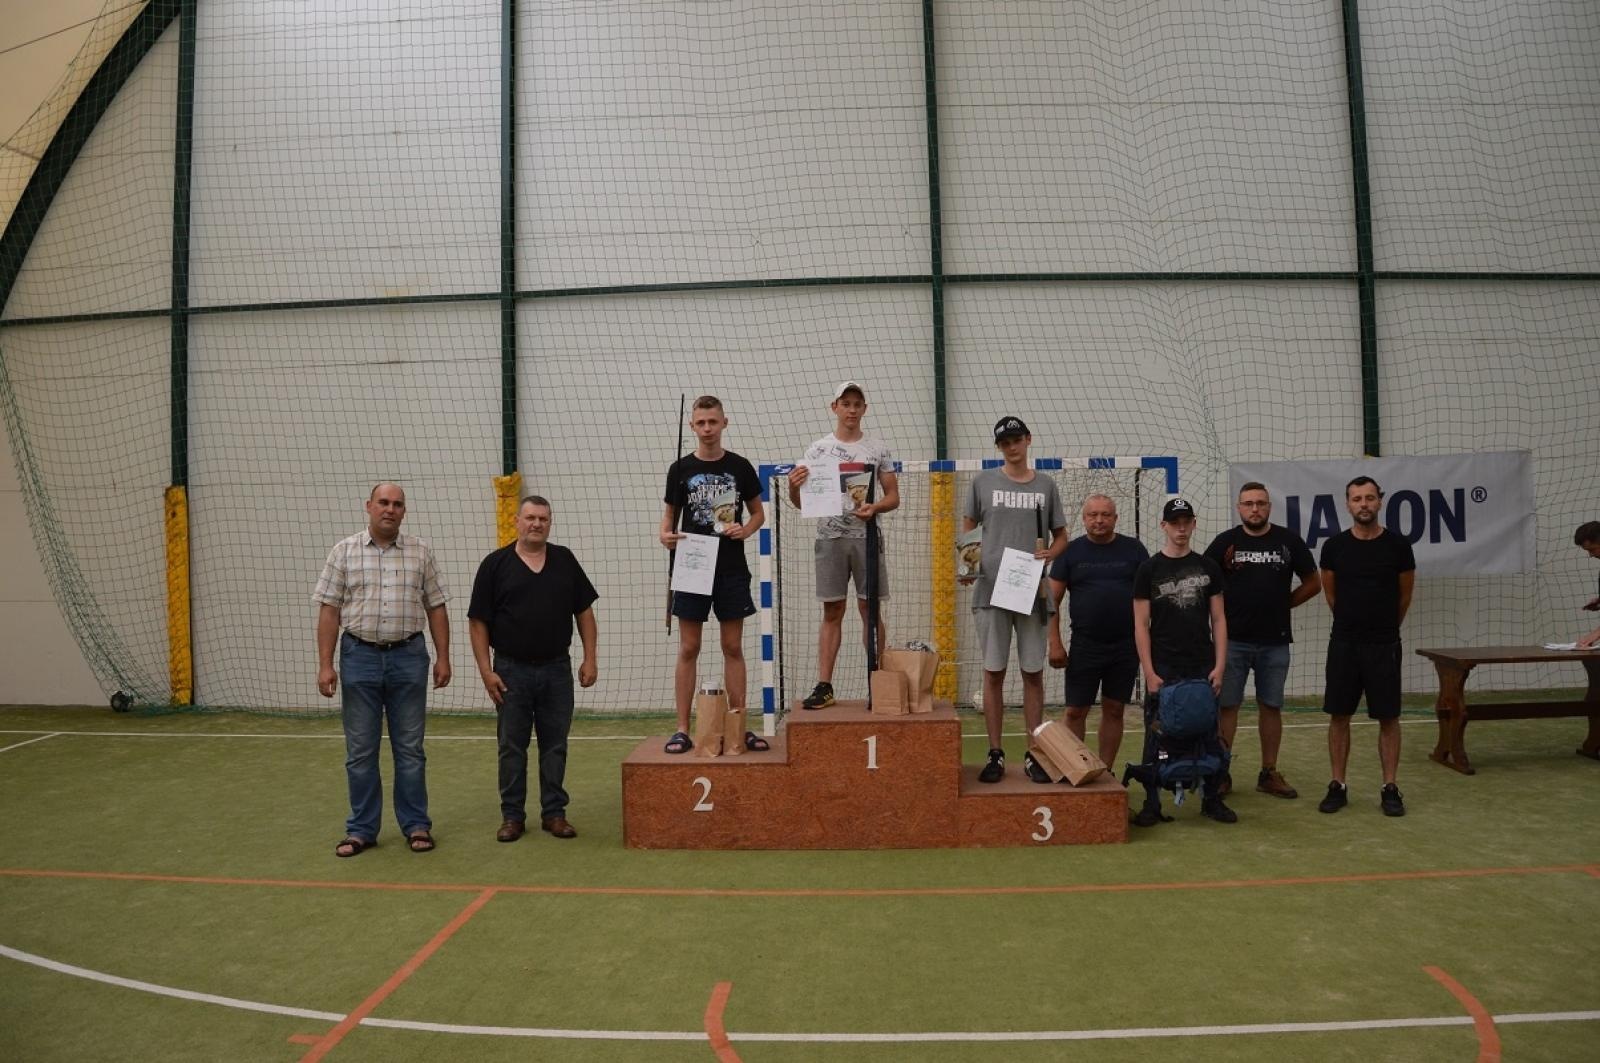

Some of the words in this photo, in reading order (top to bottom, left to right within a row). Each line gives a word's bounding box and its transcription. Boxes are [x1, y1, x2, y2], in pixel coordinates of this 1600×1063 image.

[992, 490, 1046, 511] PUMA
[1285, 488, 1467, 549] AON
[862, 734, 880, 769] 1
[692, 776, 714, 812] 2
[1031, 806, 1054, 841] 3
